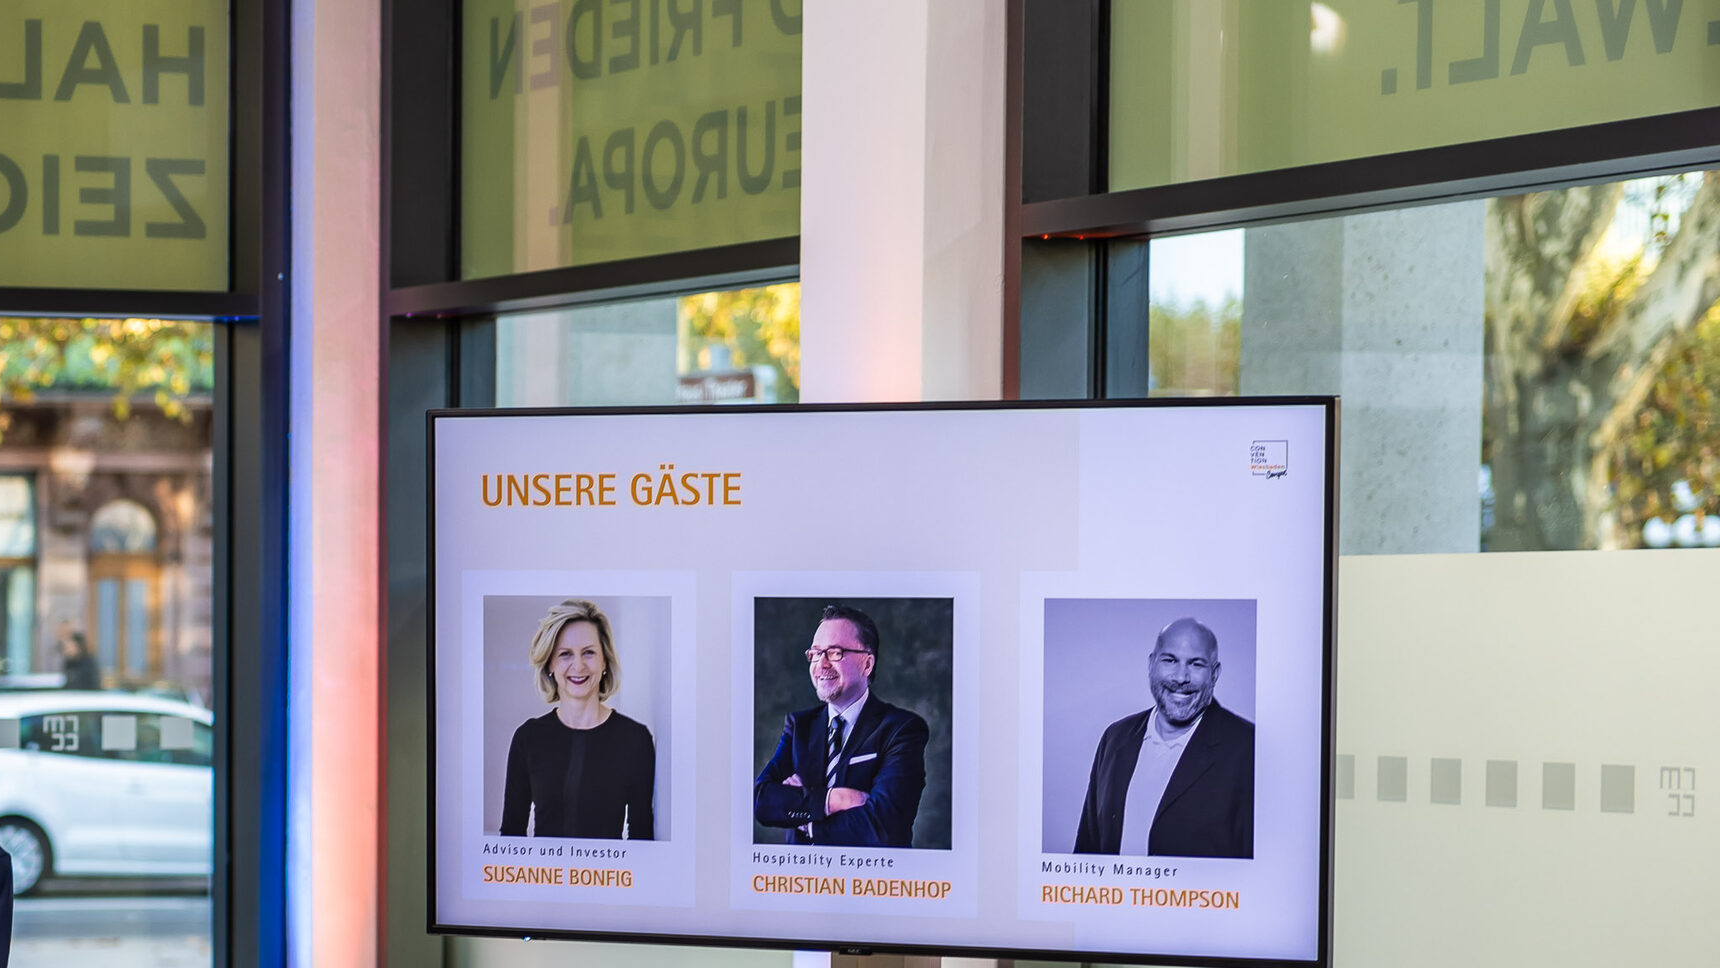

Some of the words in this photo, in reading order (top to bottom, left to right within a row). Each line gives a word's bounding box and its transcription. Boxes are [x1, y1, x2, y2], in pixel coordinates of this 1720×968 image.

[481, 473, 617, 507] UNSERE
[630, 463, 742, 506] GÄSTE
[482, 843, 533, 856] Advisor
[539, 846, 563, 857] und
[569, 845, 627, 859] Investor
[752, 851, 833, 868] Hospitality
[839, 854, 894, 869] Experte
[483, 865, 564, 885] SUSANNE
[569, 868, 633, 888] BONFIG
[1041, 861, 1105, 877] Mobility
[1113, 864, 1178, 879] Manager
[752, 875, 846, 895] CHRISTIAN
[851, 878, 953, 899] BADENHOP
[1041, 885, 1124, 906] RICHARD
[1129, 887, 1240, 910] THOMPSON
